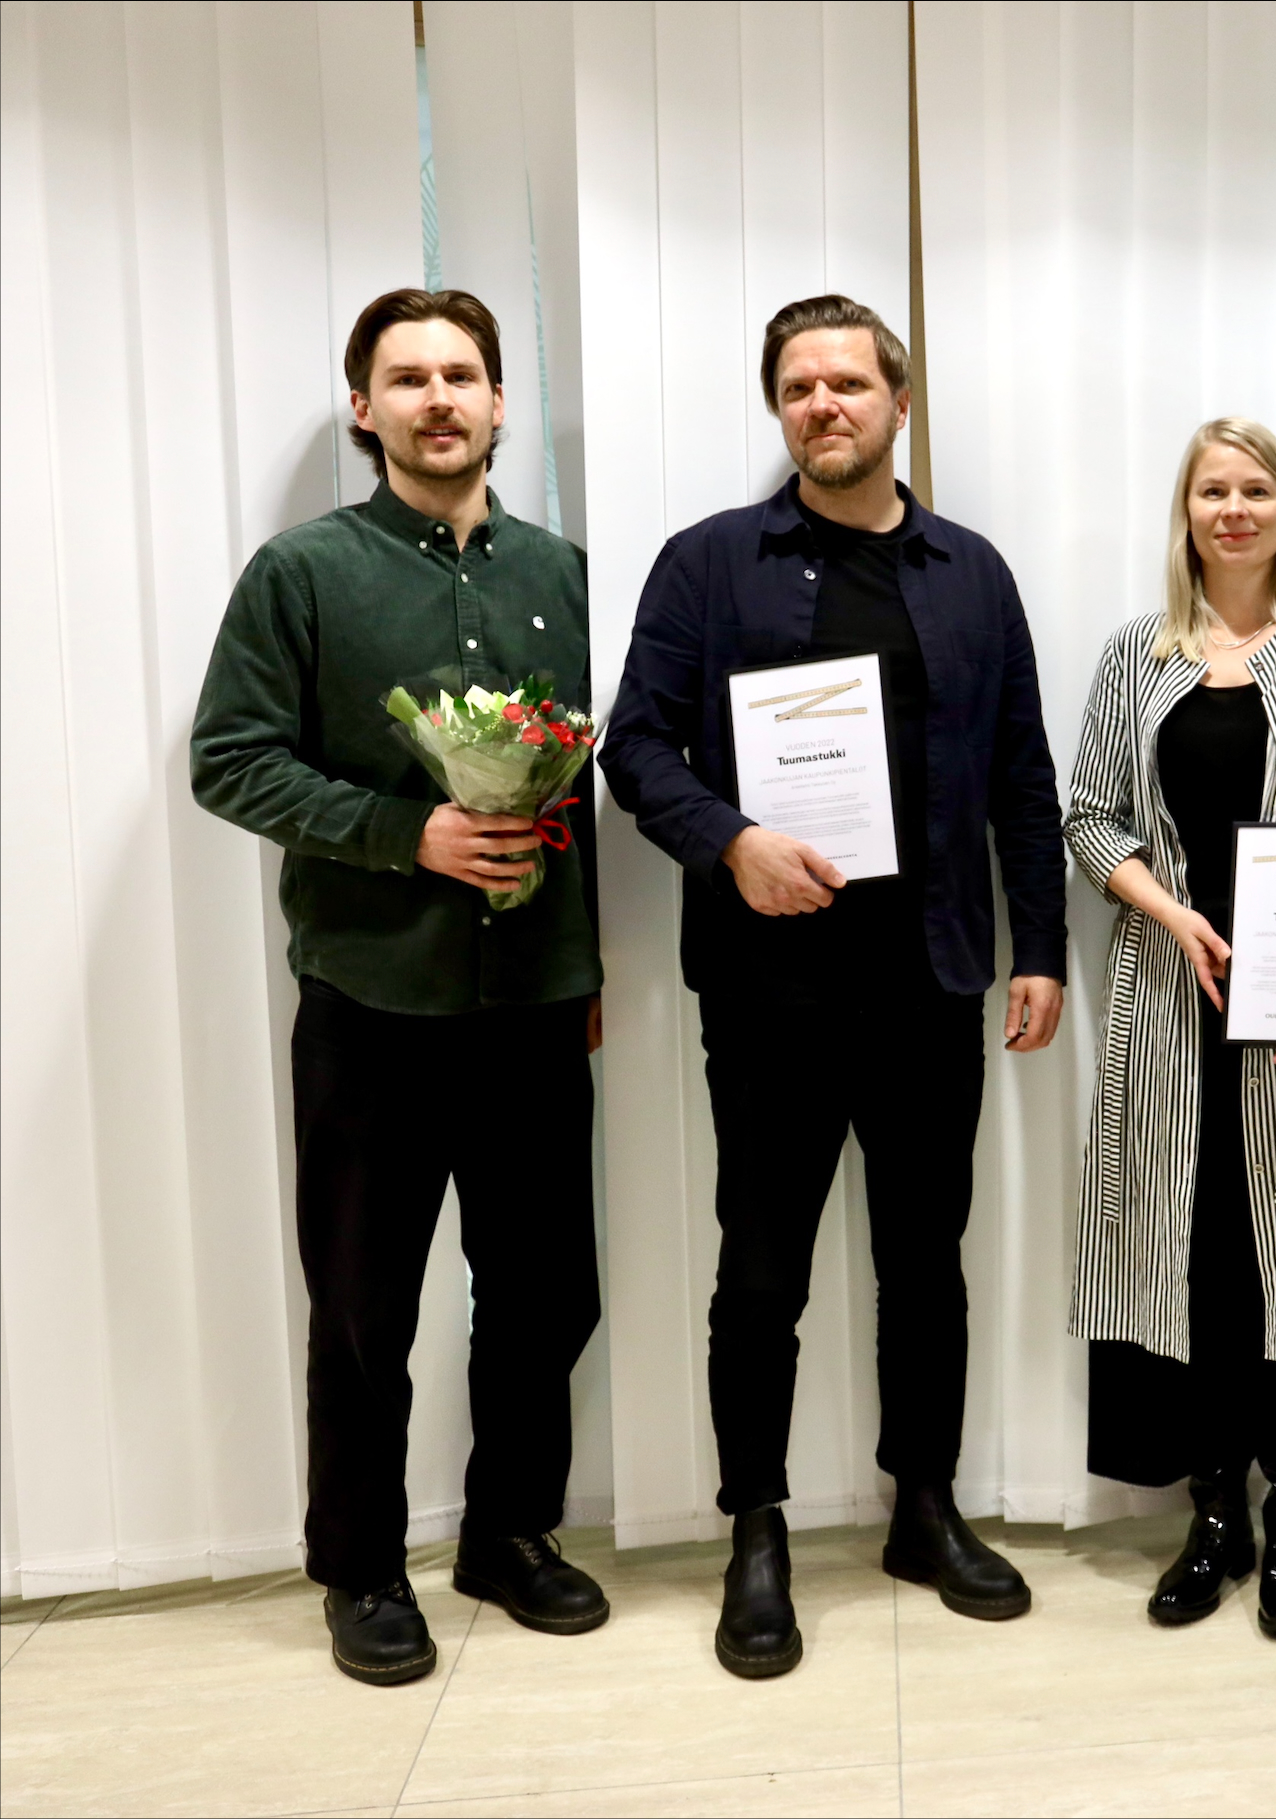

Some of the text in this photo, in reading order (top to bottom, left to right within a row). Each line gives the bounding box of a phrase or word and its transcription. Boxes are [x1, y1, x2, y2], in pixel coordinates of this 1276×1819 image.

[785, 738, 835, 751] VUODEN 2022
[776, 748, 846, 766] Tuumastukki
